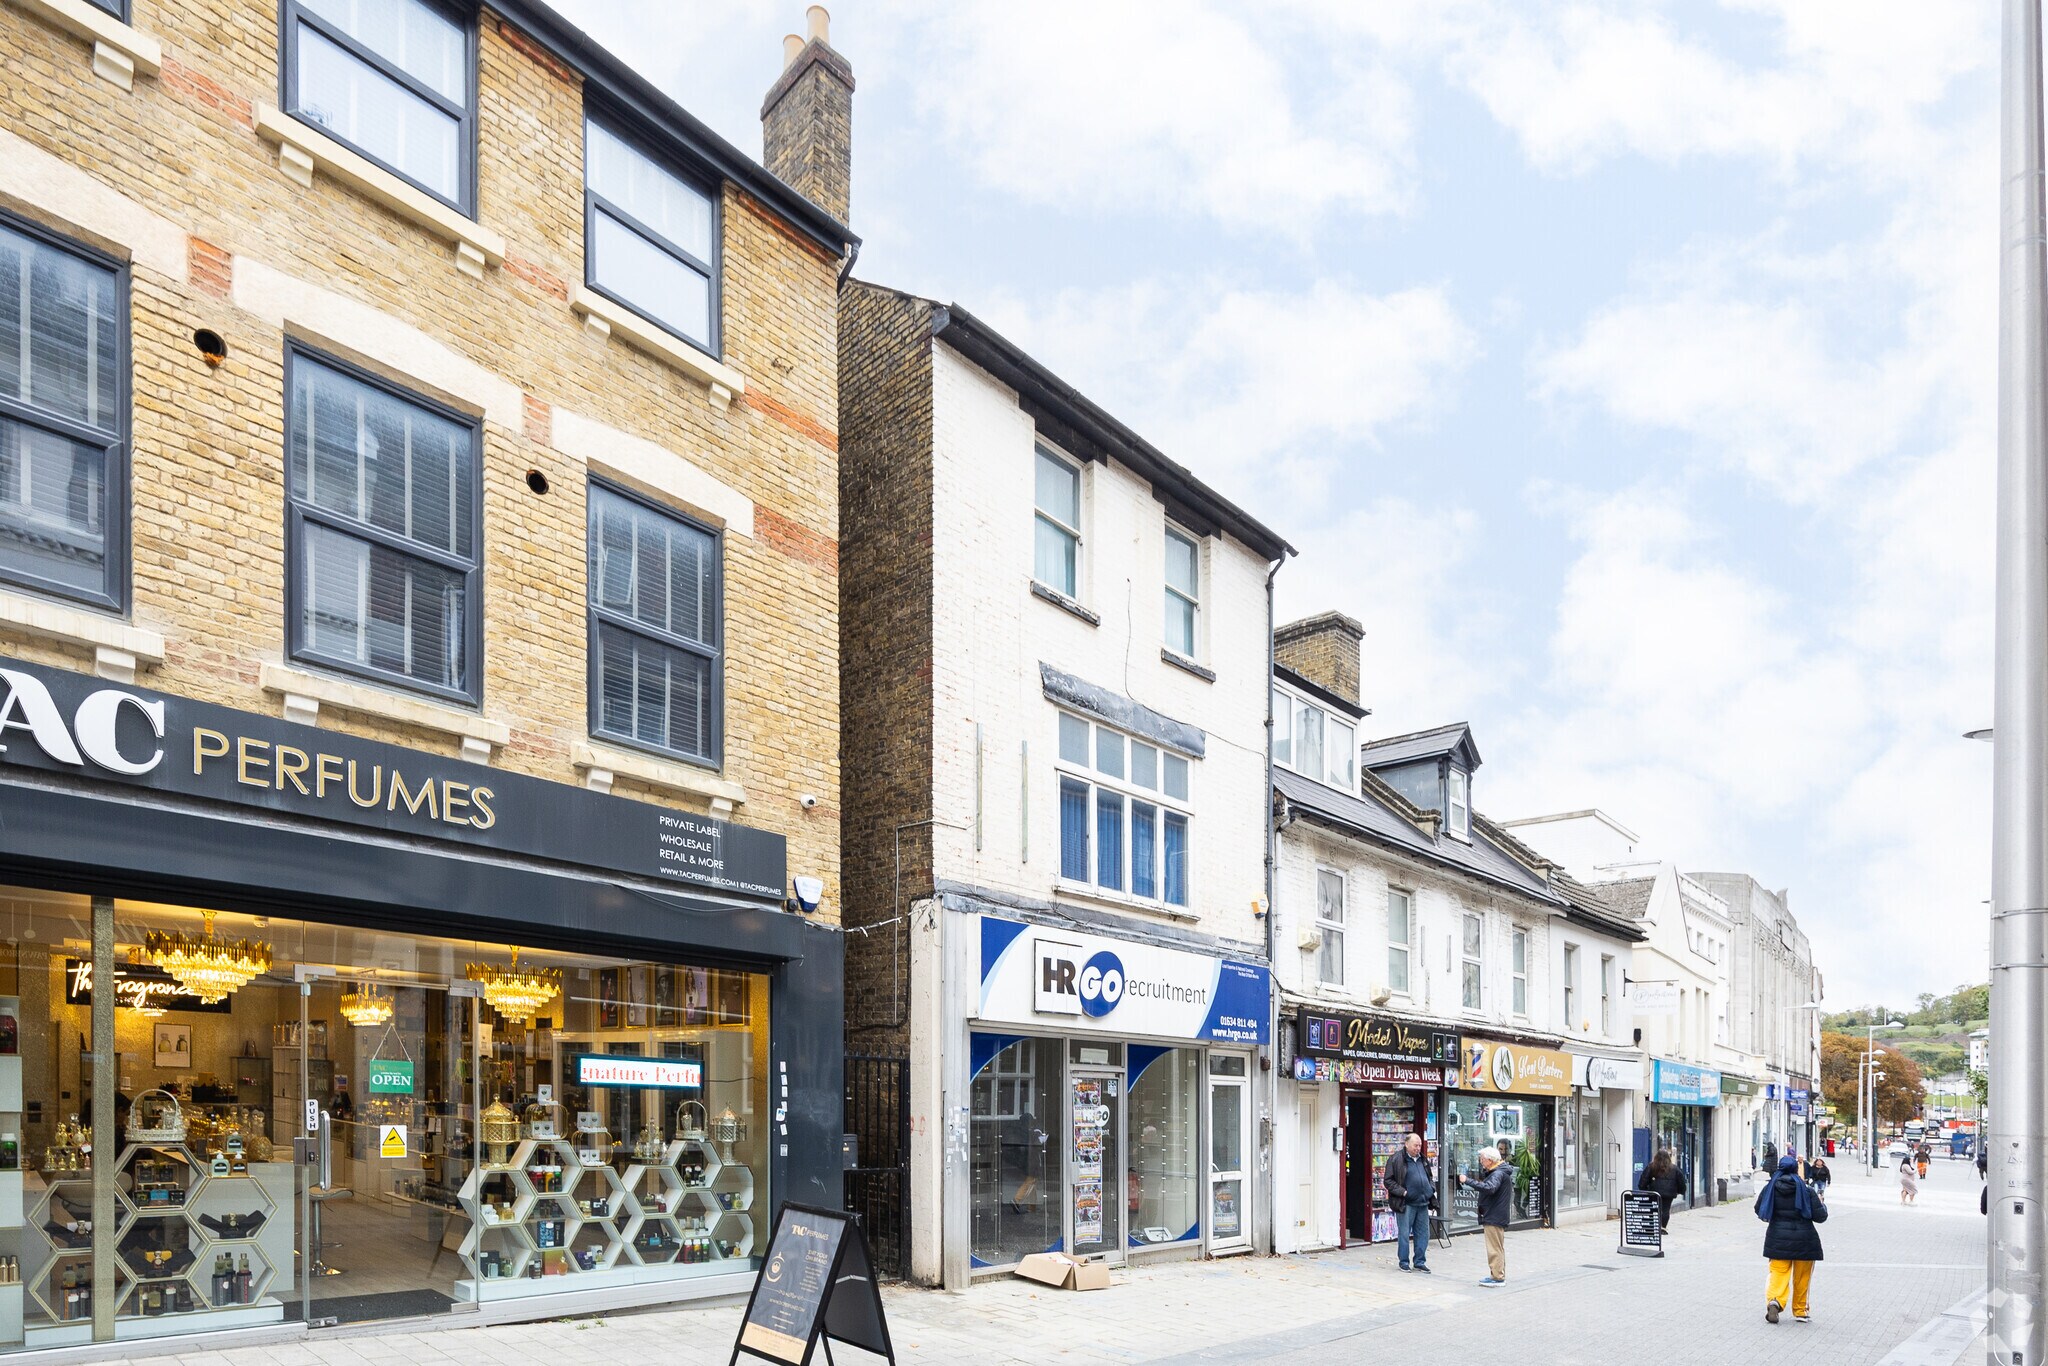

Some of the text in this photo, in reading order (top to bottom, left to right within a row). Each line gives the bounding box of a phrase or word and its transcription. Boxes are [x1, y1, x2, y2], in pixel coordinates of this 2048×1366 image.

[193, 726, 497, 830] PERFUMES
[659, 816, 721, 838] PRIVATE LABEL
[659, 833, 712, 853] WHOLESALE
[659, 849, 724, 870] RETAIL & MORE
[660, 866, 736, 888] WWW.TACPERFUMES.COM
[740, 882, 782, 896] @TACPERFUMES
[67, 962, 93, 998] th
[1043, 956, 1123, 1003] HR GO
[1123, 978, 1206, 1005] recruitment
[1212, 1028, 1258, 1042] www.hrgo.co.uk
[1348, 1018, 1429, 1055] Model Vapes
[1362, 1062, 1441, 1083] Open 7 Days a Week
[1518, 1055, 1563, 1080] Kent Barbers
[371, 1074, 412, 1086] OPEN
[1453, 1199, 1479, 1208] ARBE
[792, 1224, 807, 1237] TAC
